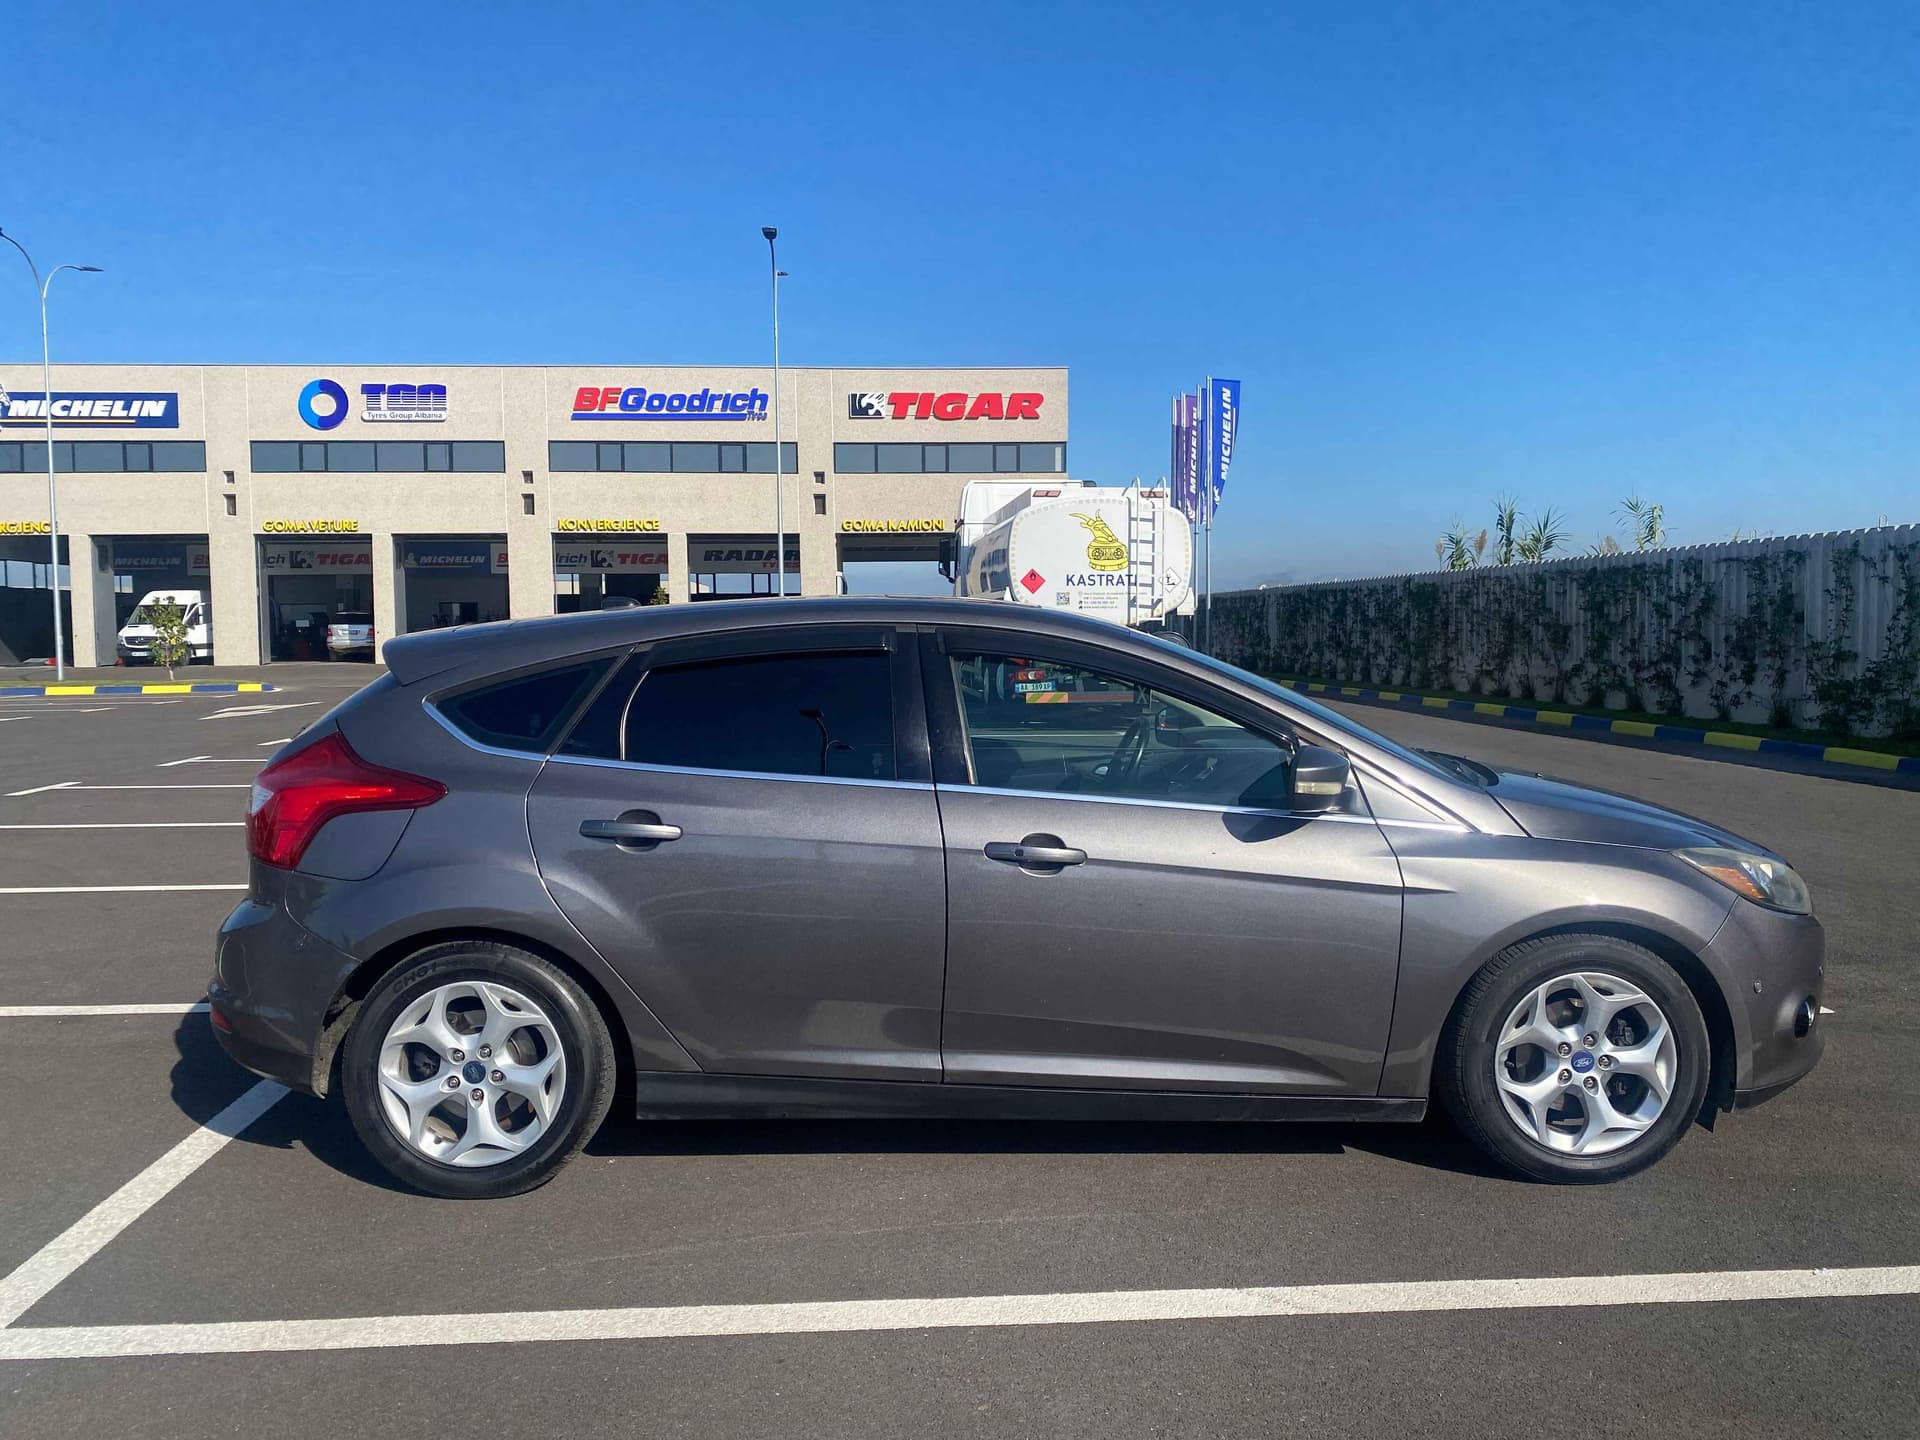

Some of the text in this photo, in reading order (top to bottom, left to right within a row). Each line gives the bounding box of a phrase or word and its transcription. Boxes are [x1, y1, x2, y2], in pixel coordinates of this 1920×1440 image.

[573, 387, 769, 412] BFGoodrich
[8, 400, 168, 417] MICHELIN
[887, 393, 1044, 420] TIGAR
[367, 411, 443, 420] Tyres Group Albania
[1221, 387, 1231, 480] MICHELIN
[263, 519, 358, 532] GOMA VETURE
[842, 519, 884, 532] GOMA
[114, 557, 181, 566] MICHELIN
[316, 553, 371, 565] TIGA
[420, 555, 485, 564] MICHELIN
[617, 553, 668, 565] TIGA
